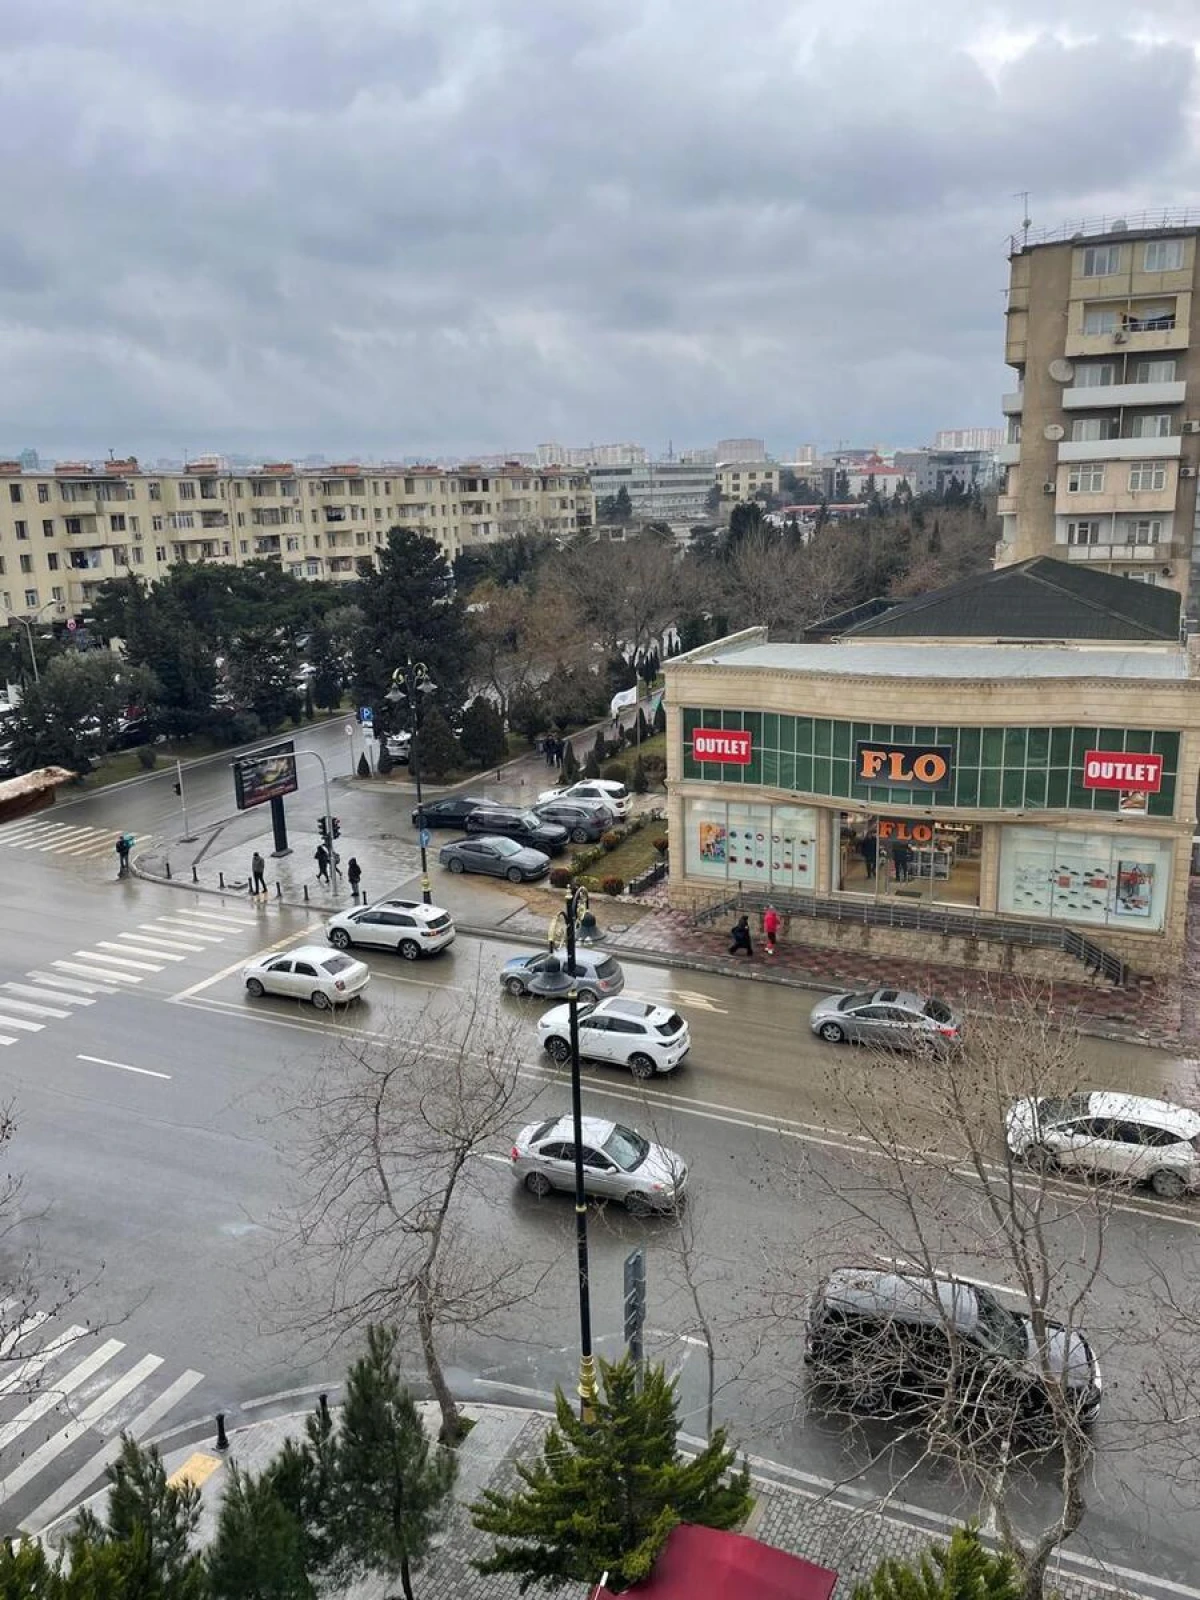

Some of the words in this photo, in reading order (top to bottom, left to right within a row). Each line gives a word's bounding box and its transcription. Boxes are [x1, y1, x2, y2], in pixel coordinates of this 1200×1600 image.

[696, 737, 749, 756] OUTLET
[861, 750, 946, 783] FLO
[1087, 760, 1158, 782] OUTLET
[878, 820, 933, 842] FLO
